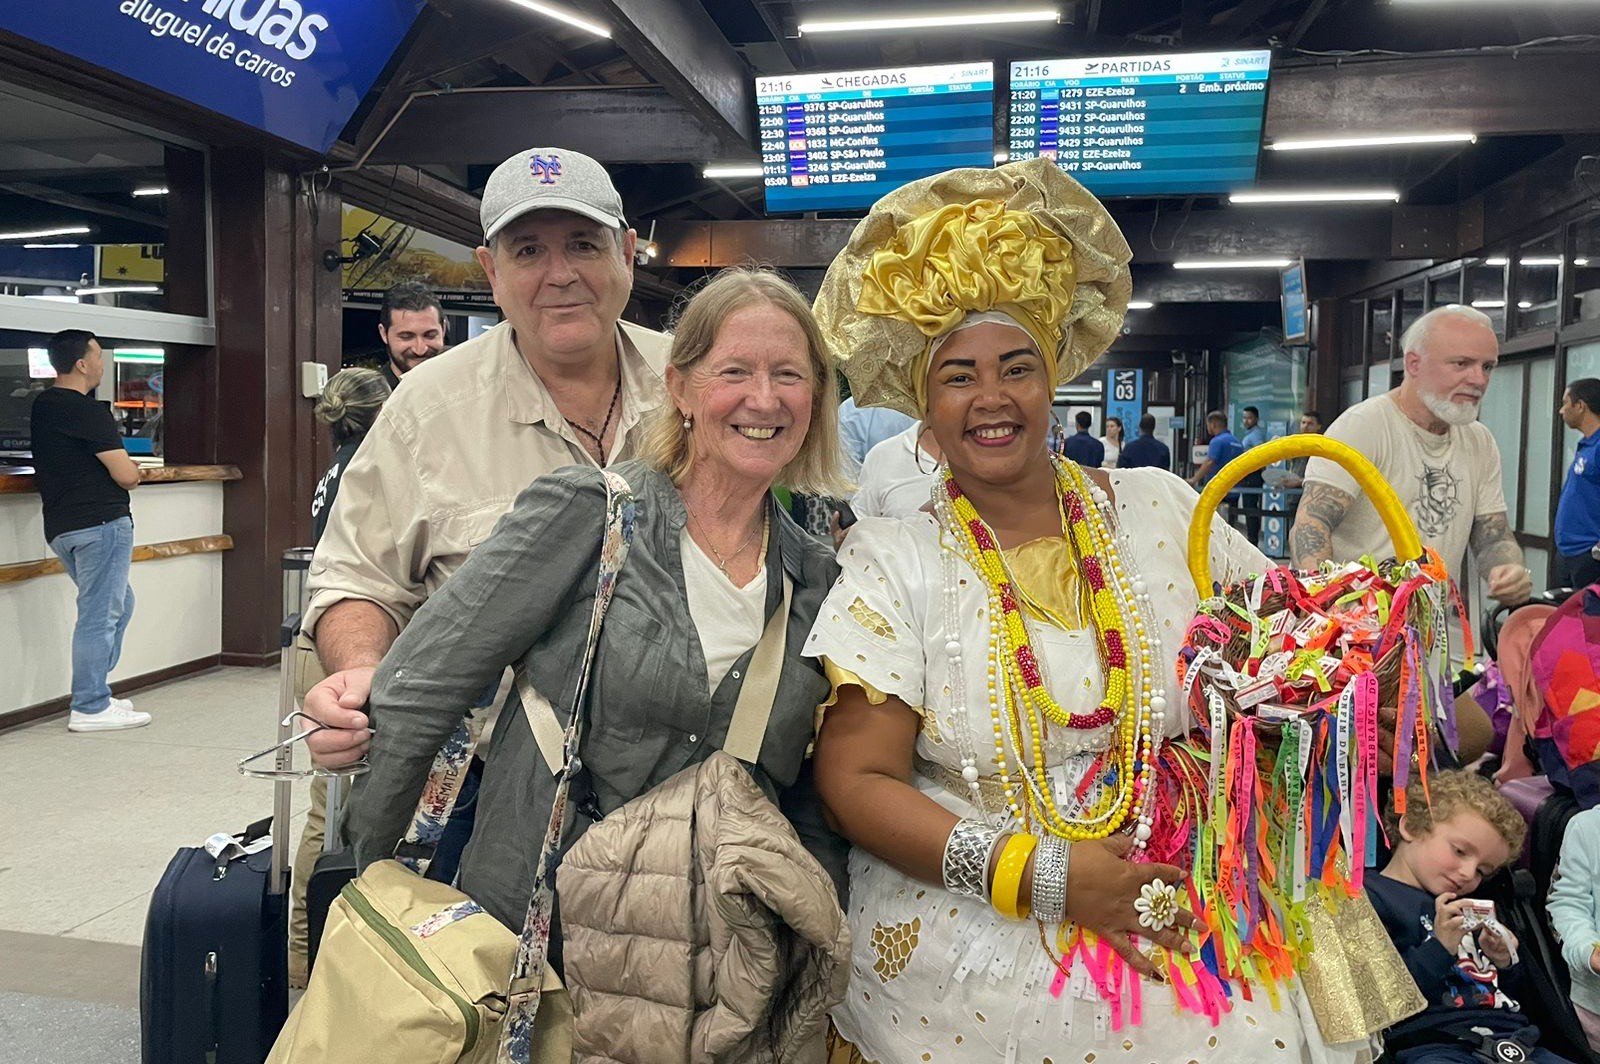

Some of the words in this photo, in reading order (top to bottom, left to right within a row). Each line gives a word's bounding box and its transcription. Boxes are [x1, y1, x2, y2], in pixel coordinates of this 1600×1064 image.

[119, 0, 212, 48] aluguel
[205, 32, 236, 60] de
[234, 49, 296, 87] carros
[1015, 65, 1049, 77] 21:16
[1101, 60, 1171, 74] PARTIDAS
[760, 80, 792, 93] 21:16
[836, 73, 907, 88] CHEGADAS
[1010, 91, 1036, 100] 21:20
[1060, 88, 1083, 98] 1279
[1085, 86, 1135, 97] EZE-Ezeiza
[1179, 84, 1187, 94] 2
[1198, 81, 1223, 93] Emb.
[1224, 81, 1265, 94] próximo
[759, 105, 783, 115] 21:30
[803, 102, 826, 112] 9376
[827, 99, 884, 111] SP-Guarulhos
[1010, 103, 1036, 112] 21:20
[1059, 101, 1081, 110] 9431
[1084, 98, 1146, 110] SP-Guarulhos
[760, 117, 784, 127] 22:00
[804, 115, 826, 124] 9372
[828, 111, 885, 123] SP-Guarulhos
[1010, 115, 1035, 125] 22:00
[1058, 113, 1081, 123] 9437
[1084, 111, 1145, 122] SP-Guarulhos
[828, 124, 885, 136] SP-Guarulhos
[1010, 127, 1035, 137] 22:30
[1058, 126, 1081, 135] 9433
[1083, 124, 1144, 135] SP-Guarulhos
[829, 136, 879, 147] MG-Confins
[1009, 140, 1035, 149] 23:00
[1057, 138, 1080, 148] 9429
[1082, 136, 1144, 147] SP-Guarulhos
[859, 147, 884, 157] Paulo
[1057, 150, 1080, 159] 7492
[1082, 149, 1131, 159] EZE-Ezeiza
[830, 160, 887, 171] SP-Guarulhos
[1081, 161, 1141, 171] SP-Guarulhos
[1115, 384, 1134, 400] 03
